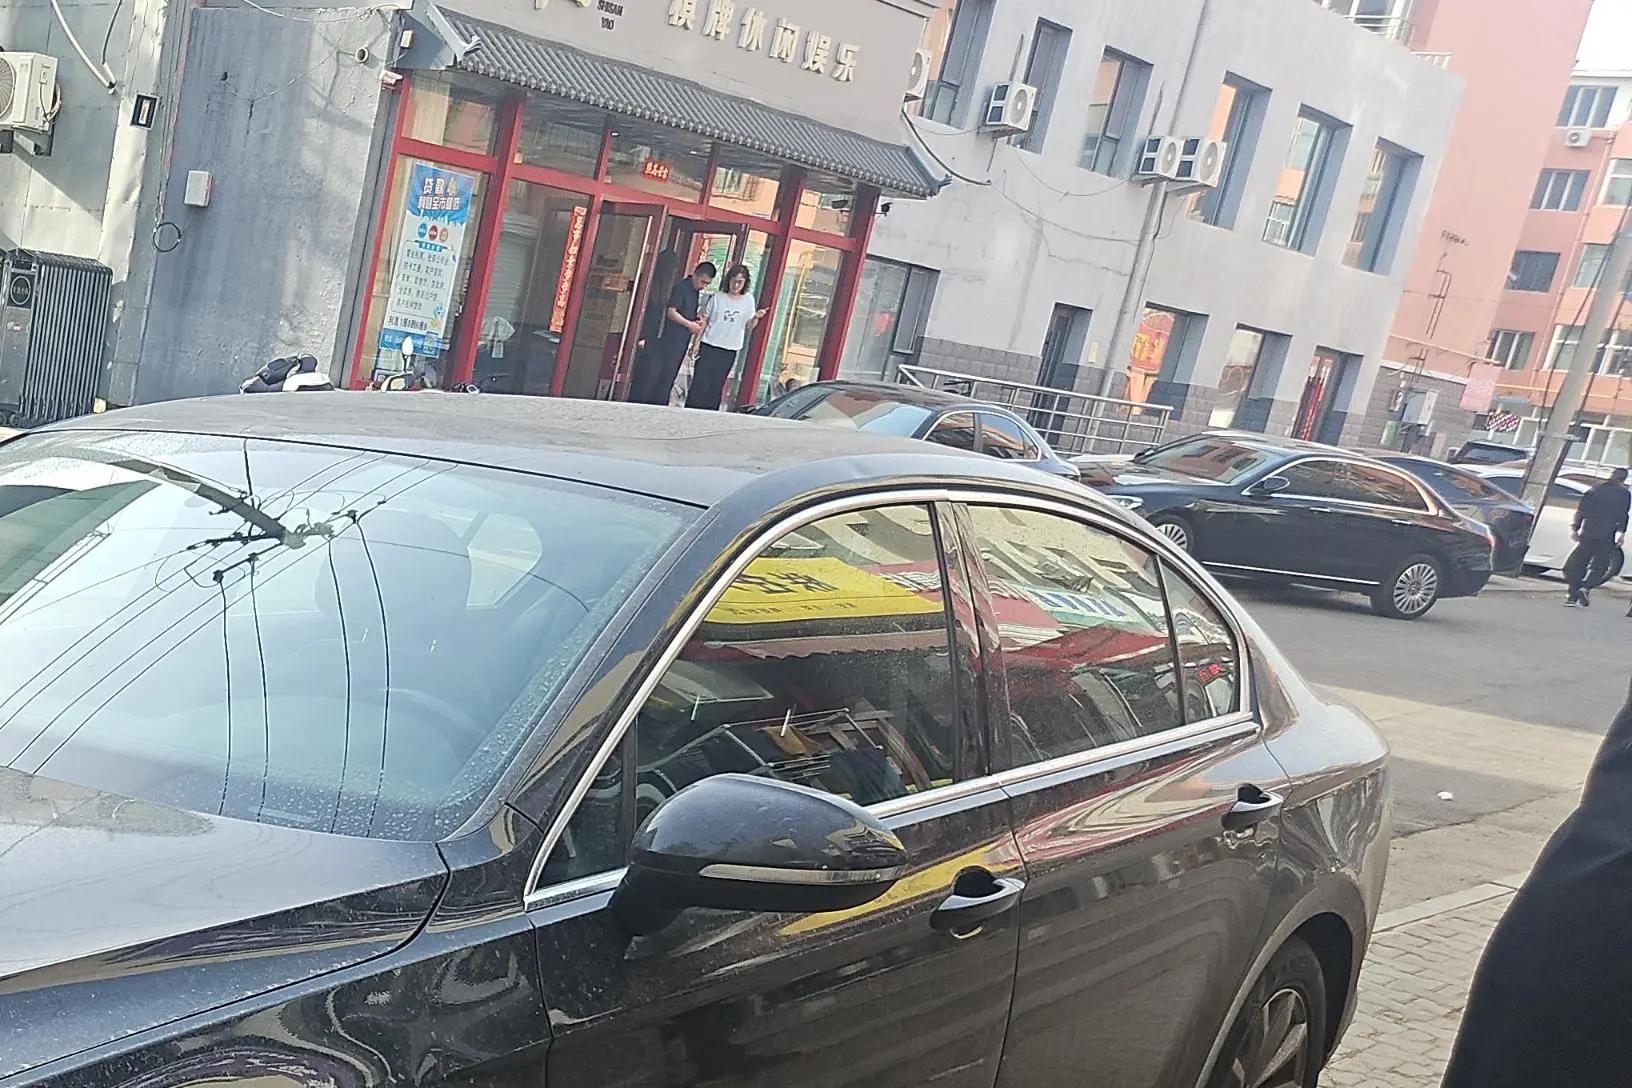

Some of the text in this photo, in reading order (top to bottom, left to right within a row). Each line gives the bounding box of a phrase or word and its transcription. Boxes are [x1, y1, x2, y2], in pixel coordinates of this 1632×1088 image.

[668, 0, 860, 82] 棋牌休闲娱乐
